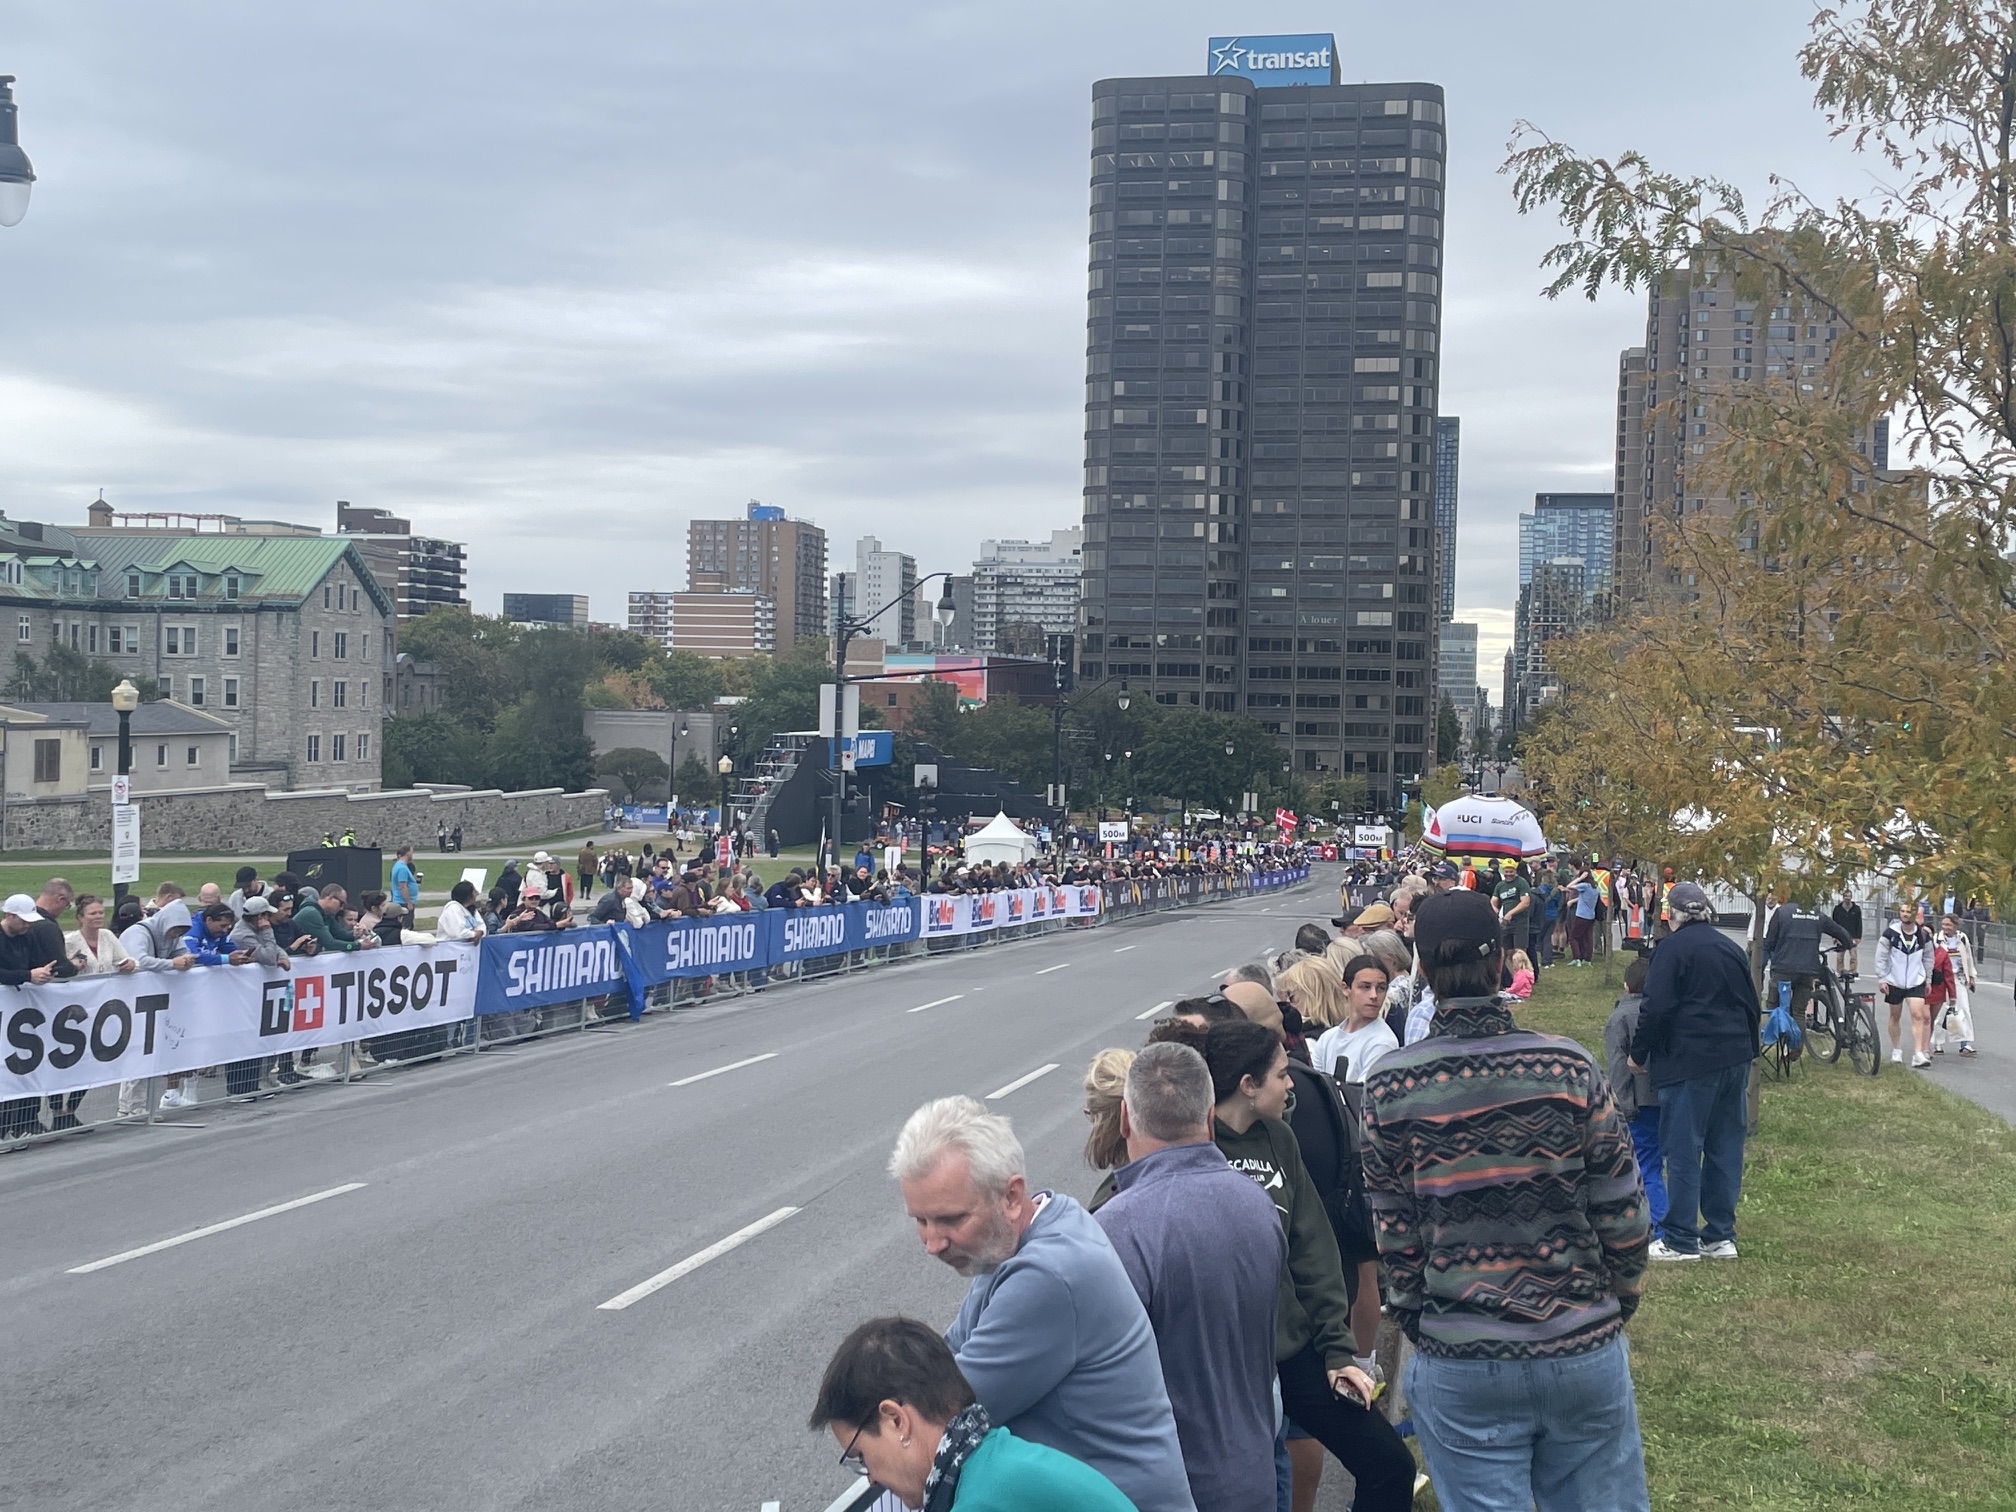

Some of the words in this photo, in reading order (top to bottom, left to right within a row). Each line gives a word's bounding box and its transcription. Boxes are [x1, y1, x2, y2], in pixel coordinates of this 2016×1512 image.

[1246, 46, 1330, 70] transat
[1310, 615, 1338, 624] louer
[1461, 814, 1482, 824] UCI
[784, 913, 845, 953] SHIMANO
[864, 907, 912, 940] SHIMANO
[666, 923, 756, 971] SHIMANO
[331, 959, 458, 1026] TISSOT
[0, 993, 170, 1076] SSOT
